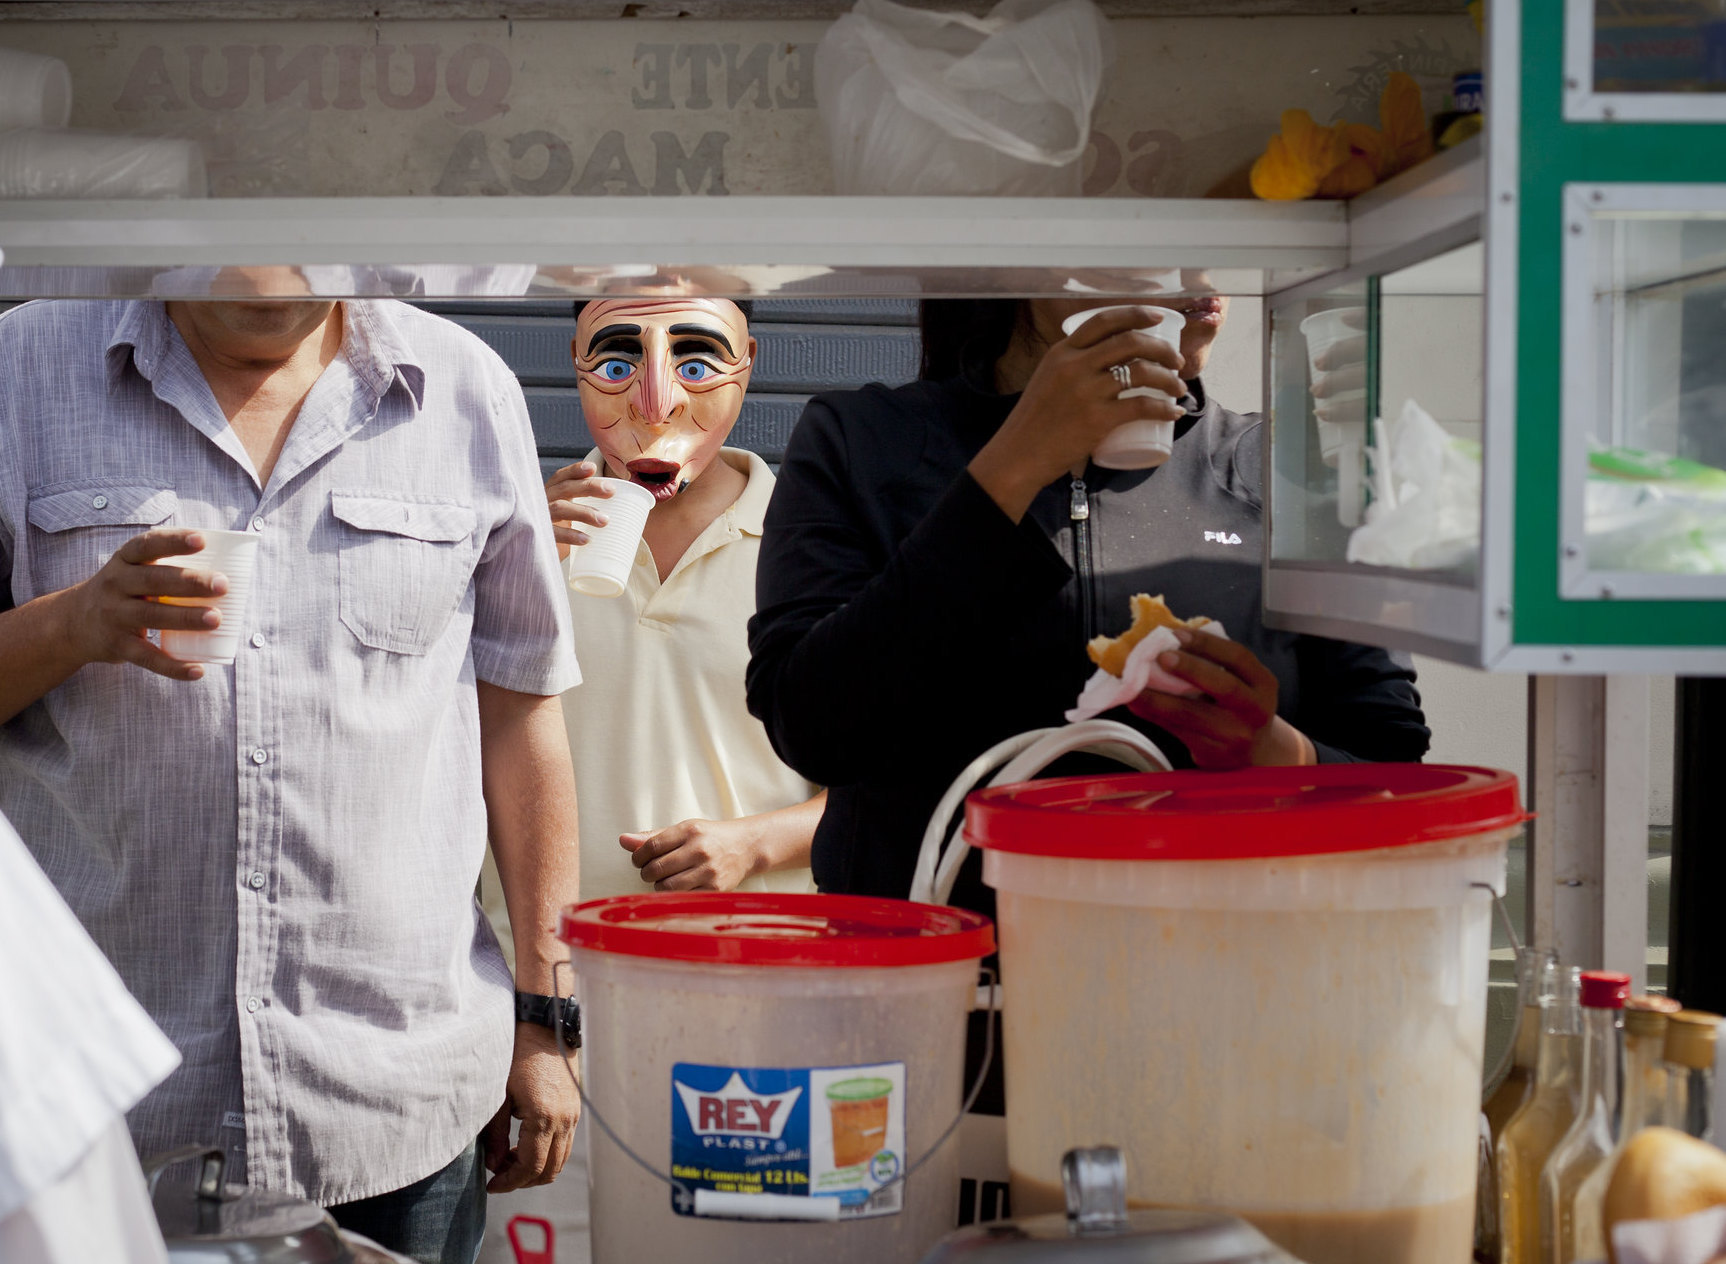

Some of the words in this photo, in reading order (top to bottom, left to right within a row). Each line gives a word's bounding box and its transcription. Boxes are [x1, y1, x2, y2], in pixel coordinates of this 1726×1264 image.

[1204, 530, 1242, 545] FILA
[698, 1096, 783, 1133] REY
[703, 1137, 771, 1152] PLAST
[765, 1169, 784, 1184] 12
